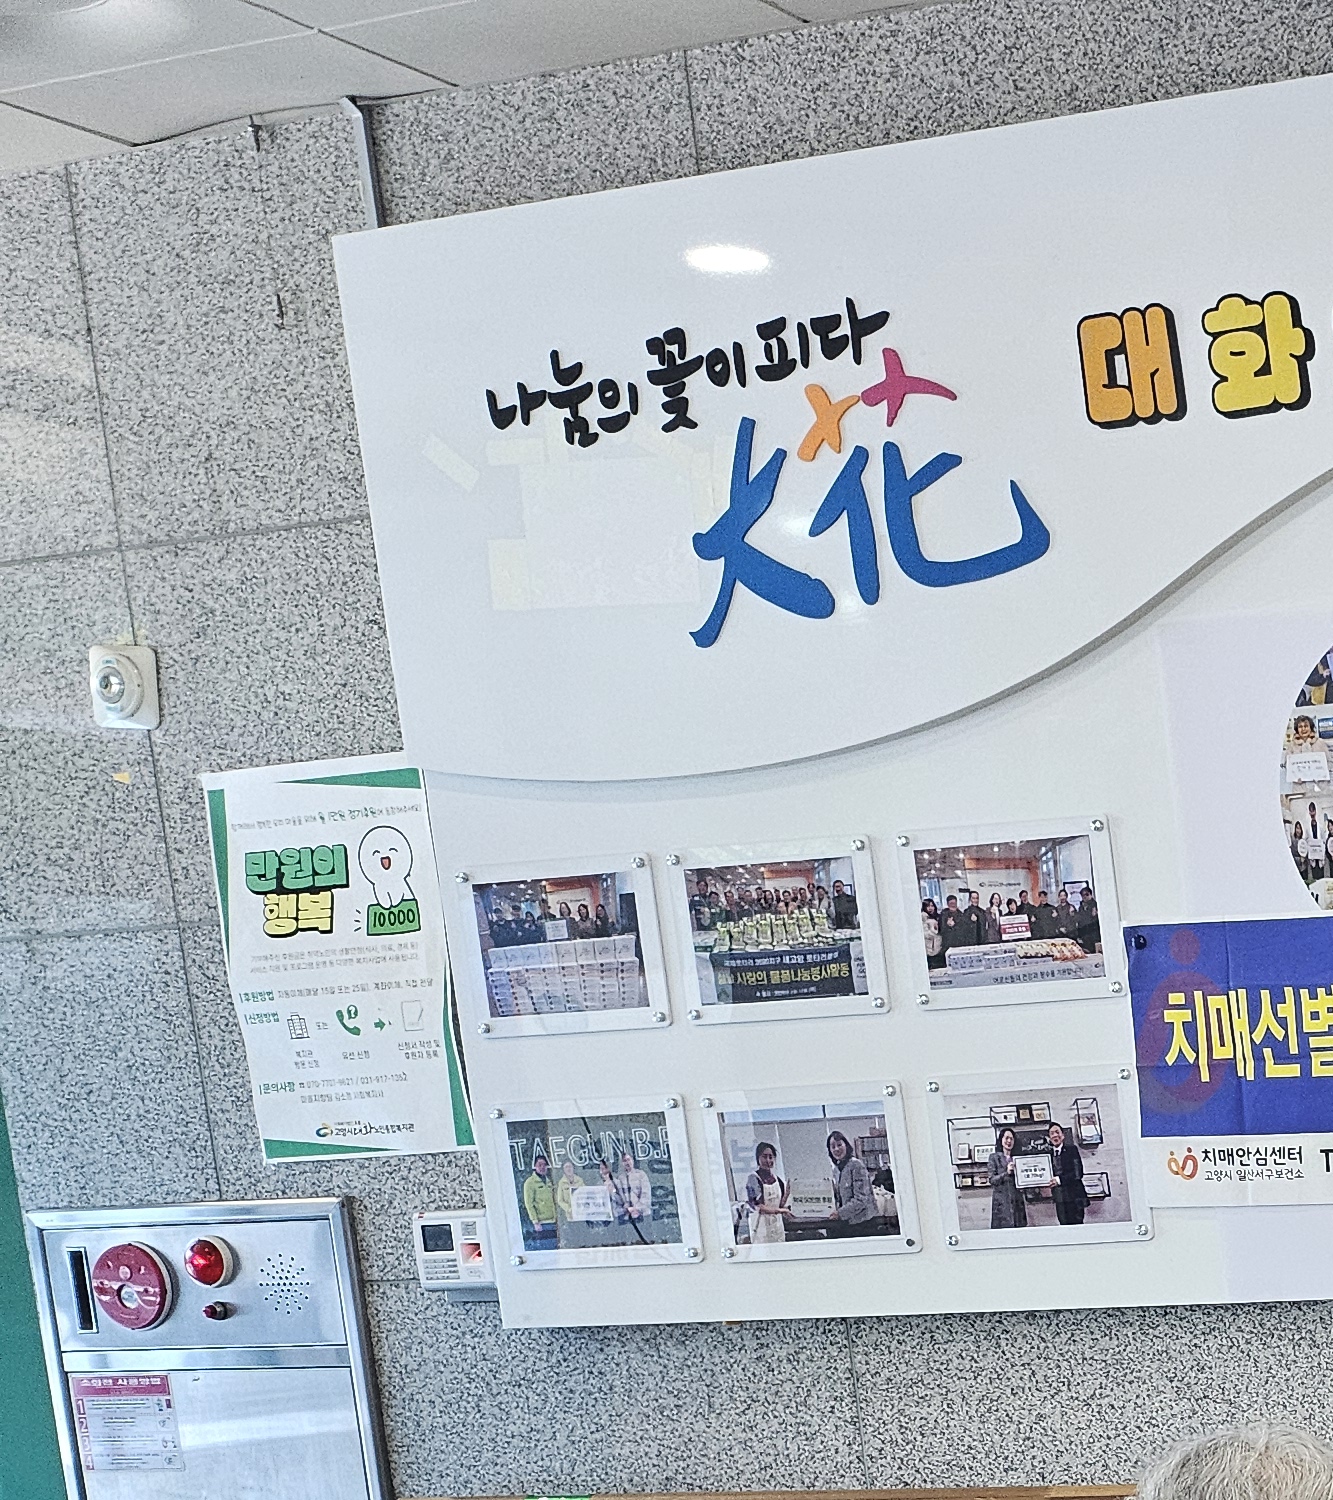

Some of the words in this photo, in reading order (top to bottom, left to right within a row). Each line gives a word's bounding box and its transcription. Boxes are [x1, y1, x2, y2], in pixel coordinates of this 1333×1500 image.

[486, 349, 638, 448] 나눔의
[646, 326, 747, 432] 꽃이
[755, 296, 891, 382] 피다
[245, 844, 350, 894] 만원의
[263, 891, 334, 938] 행복
[373, 908, 416, 928] 10000
[736, 971, 767, 986] 사랑의
[1022, 972, 1039, 982] 건강과
[243, 989, 275, 1003] 후원방법
[248, 1011, 280, 1025] 신청방법
[262, 1081, 295, 1094] 문의사항
[1201, 1146, 1303, 1168] 치매안심센터
[1204, 1170, 1234, 1181] 고양시
[1236, 1168, 1305, 1181] 일산서구보건소
